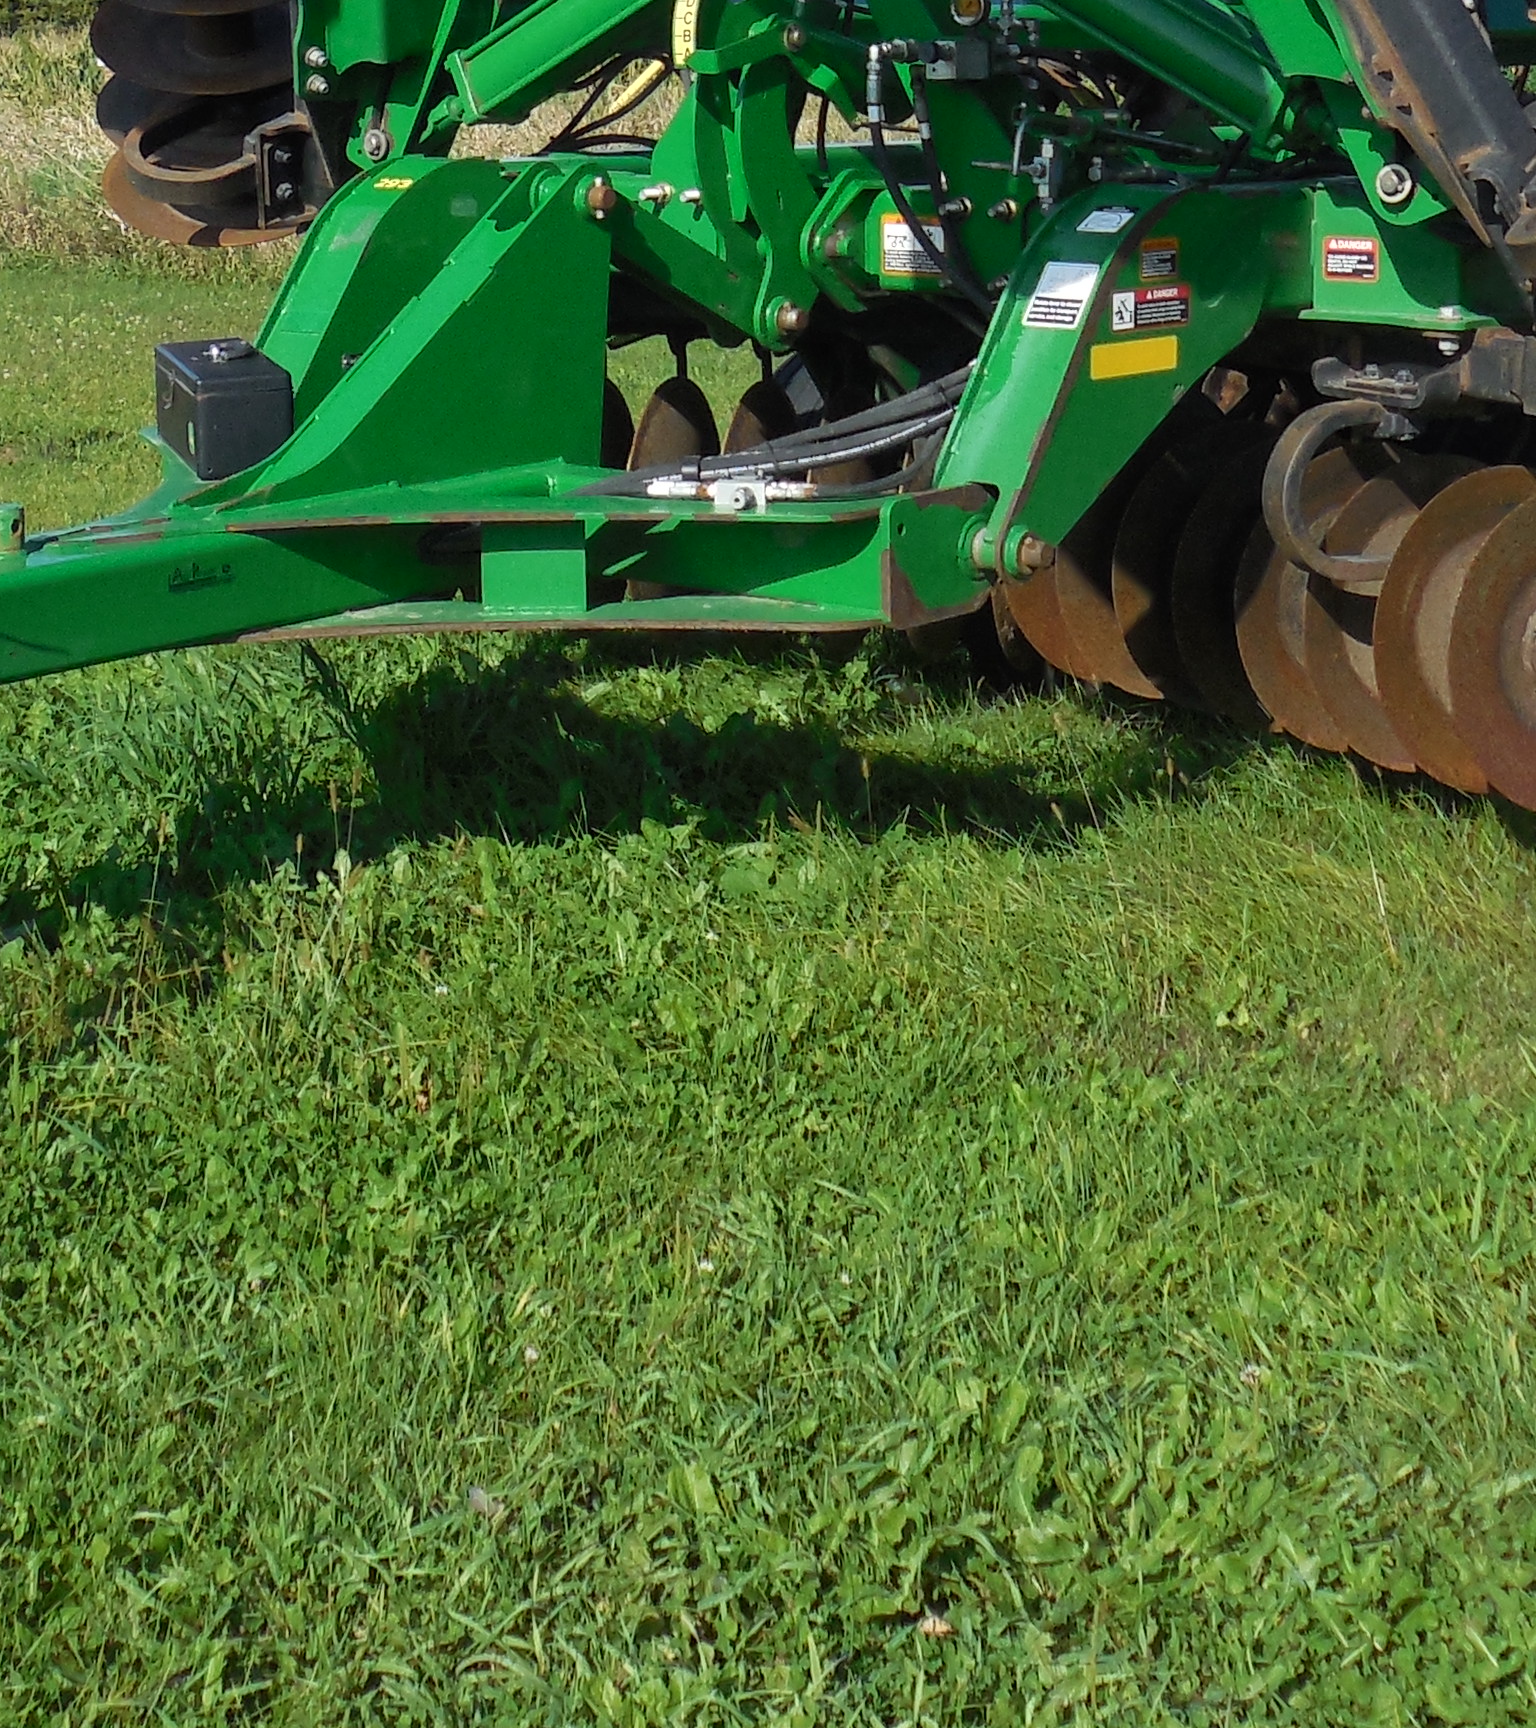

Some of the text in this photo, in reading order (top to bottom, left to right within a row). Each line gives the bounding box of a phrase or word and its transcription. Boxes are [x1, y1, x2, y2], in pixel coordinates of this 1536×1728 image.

[683, 11, 693, 25] C
[683, 29, 692, 43] B
[1337, 240, 1373, 251] DANGER
[1152, 287, 1179, 300] DANGER
